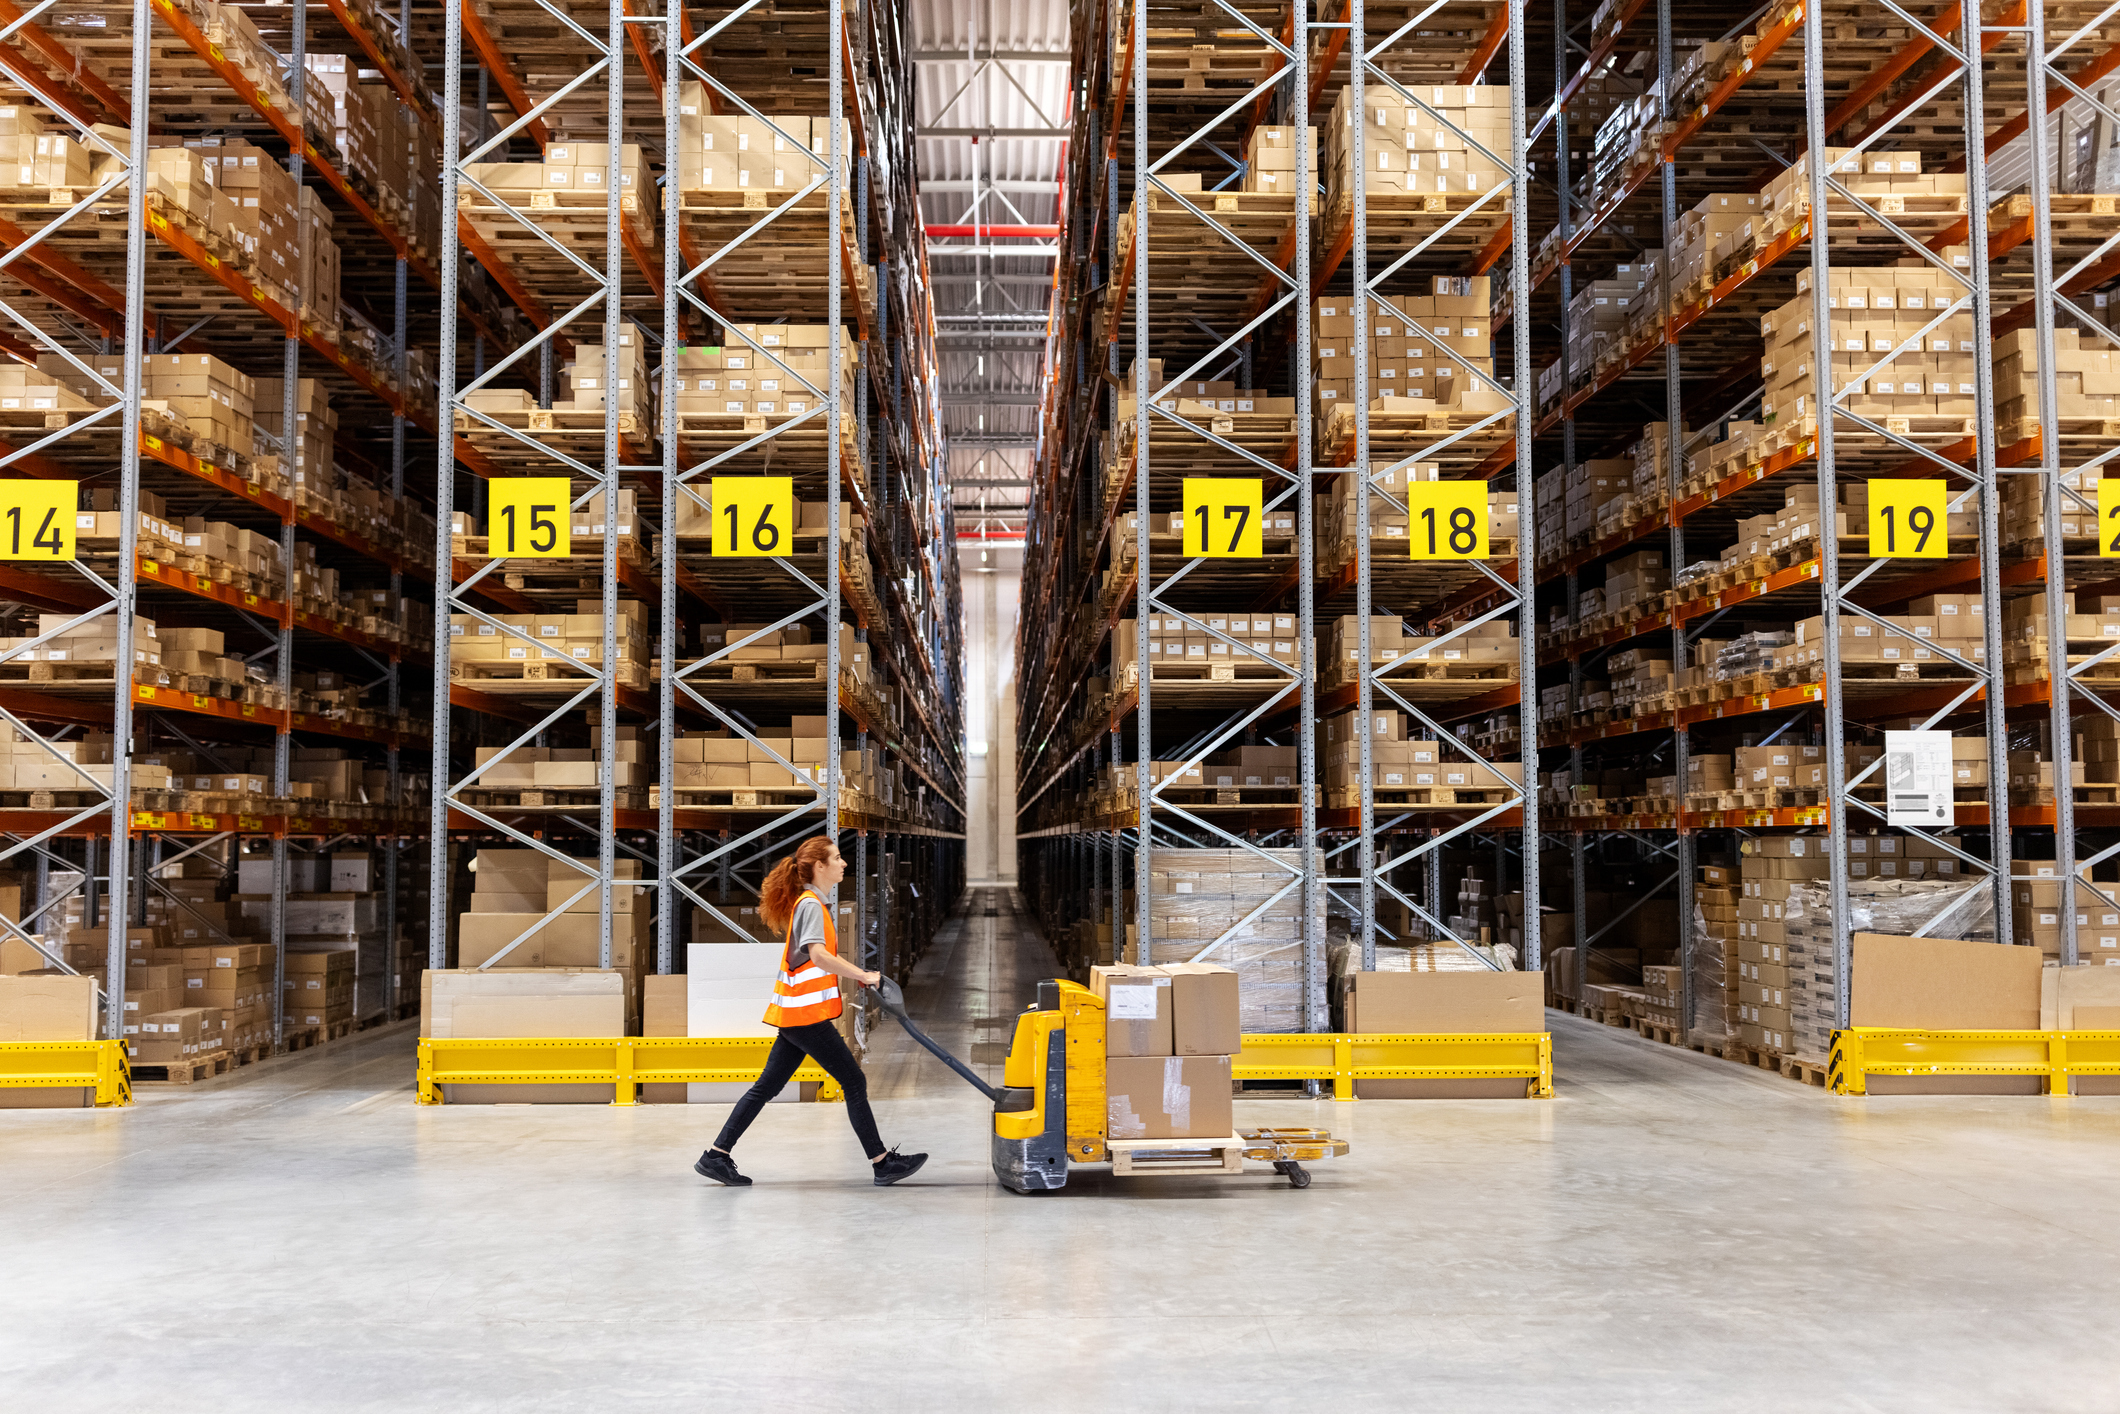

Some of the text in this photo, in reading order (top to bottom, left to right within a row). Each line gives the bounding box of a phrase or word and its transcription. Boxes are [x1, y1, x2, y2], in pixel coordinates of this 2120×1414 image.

[6, 507, 64, 555] 14
[502, 505, 557, 553] 15
[724, 504, 779, 552] 16
[1195, 505, 1250, 552] 17
[1422, 507, 1477, 555] 18
[1881, 506, 1935, 553] 19
